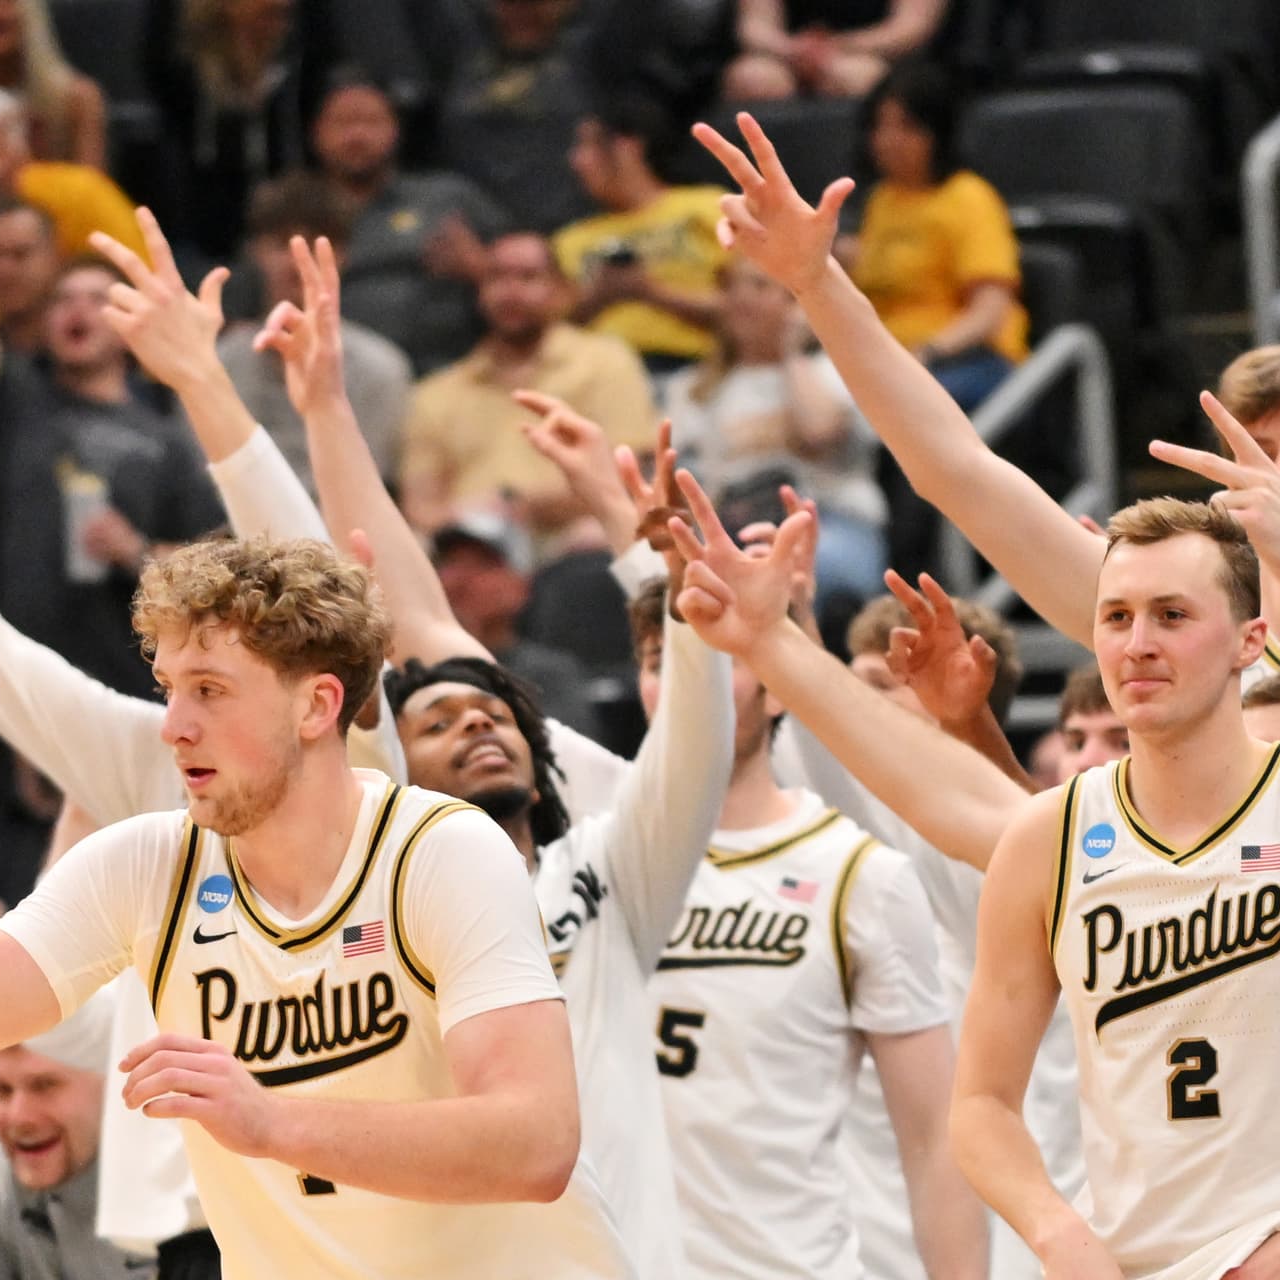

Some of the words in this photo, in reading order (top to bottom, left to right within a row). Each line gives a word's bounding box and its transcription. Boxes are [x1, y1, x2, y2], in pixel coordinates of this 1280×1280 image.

[1086, 838, 1113, 849] NCAA
[200, 891, 229, 904] NCAA
[666, 898, 810, 955] rdue
[192, 968, 409, 1062] Purdue
[1167, 1036, 1221, 1121] 2
